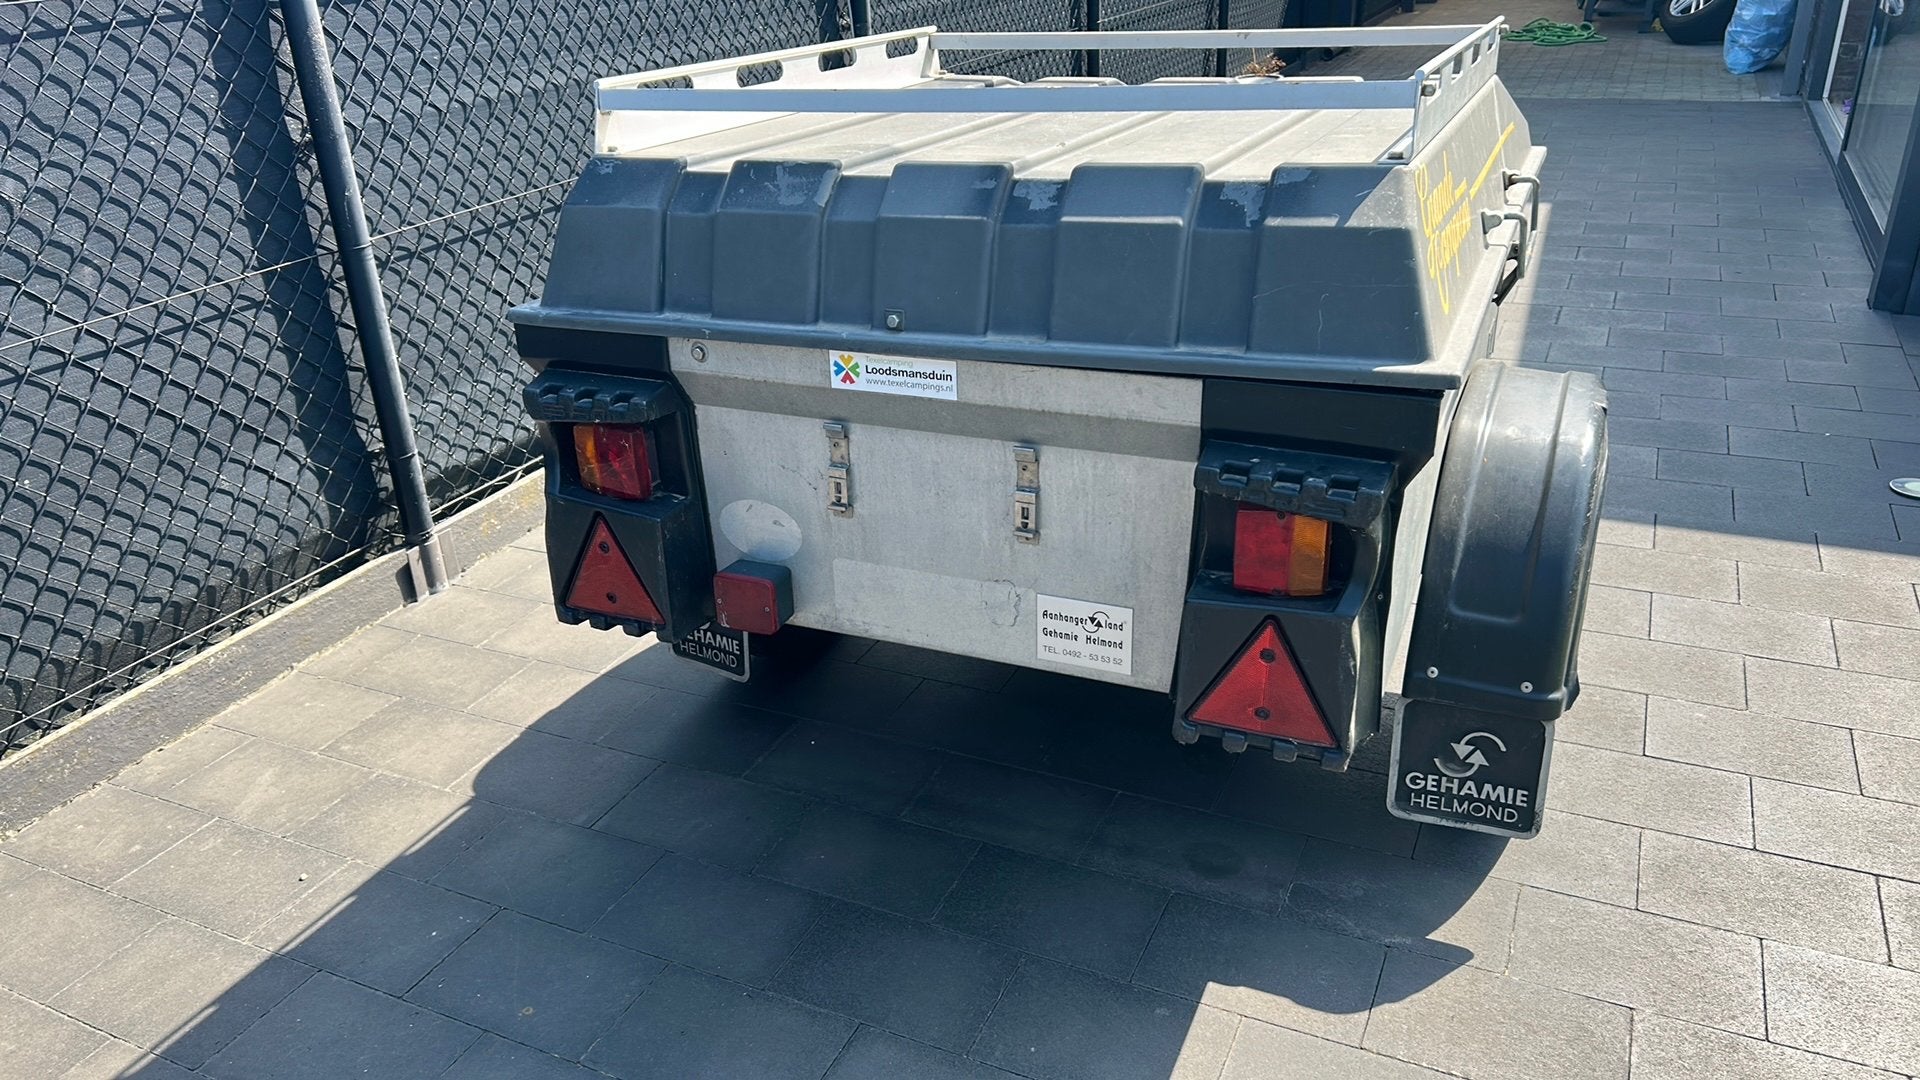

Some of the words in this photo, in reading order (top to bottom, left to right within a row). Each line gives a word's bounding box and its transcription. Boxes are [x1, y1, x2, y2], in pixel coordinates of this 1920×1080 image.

[865, 355, 914, 368] Texelcamping
[865, 364, 953, 382] Loodsmansduin
[865, 377, 954, 393] www.texelcampings.nl
[1042, 609, 1088, 626] Aanhanger
[687, 629, 740, 655] HAMIE
[1042, 627, 1079, 642] Gehamie
[1085, 634, 1123, 650] Helmond
[680, 641, 738, 668] HELMOND
[1043, 645, 1060, 655] TEL.
[1062, 648, 1082, 659] 0492
[1089, 653, 1099, 662] 53
[1100, 655, 1111, 664] 53
[1112, 657, 1123, 666] 52
[1405, 772, 1529, 808] GEHAMIE
[1410, 792, 1518, 823] HELMOND
